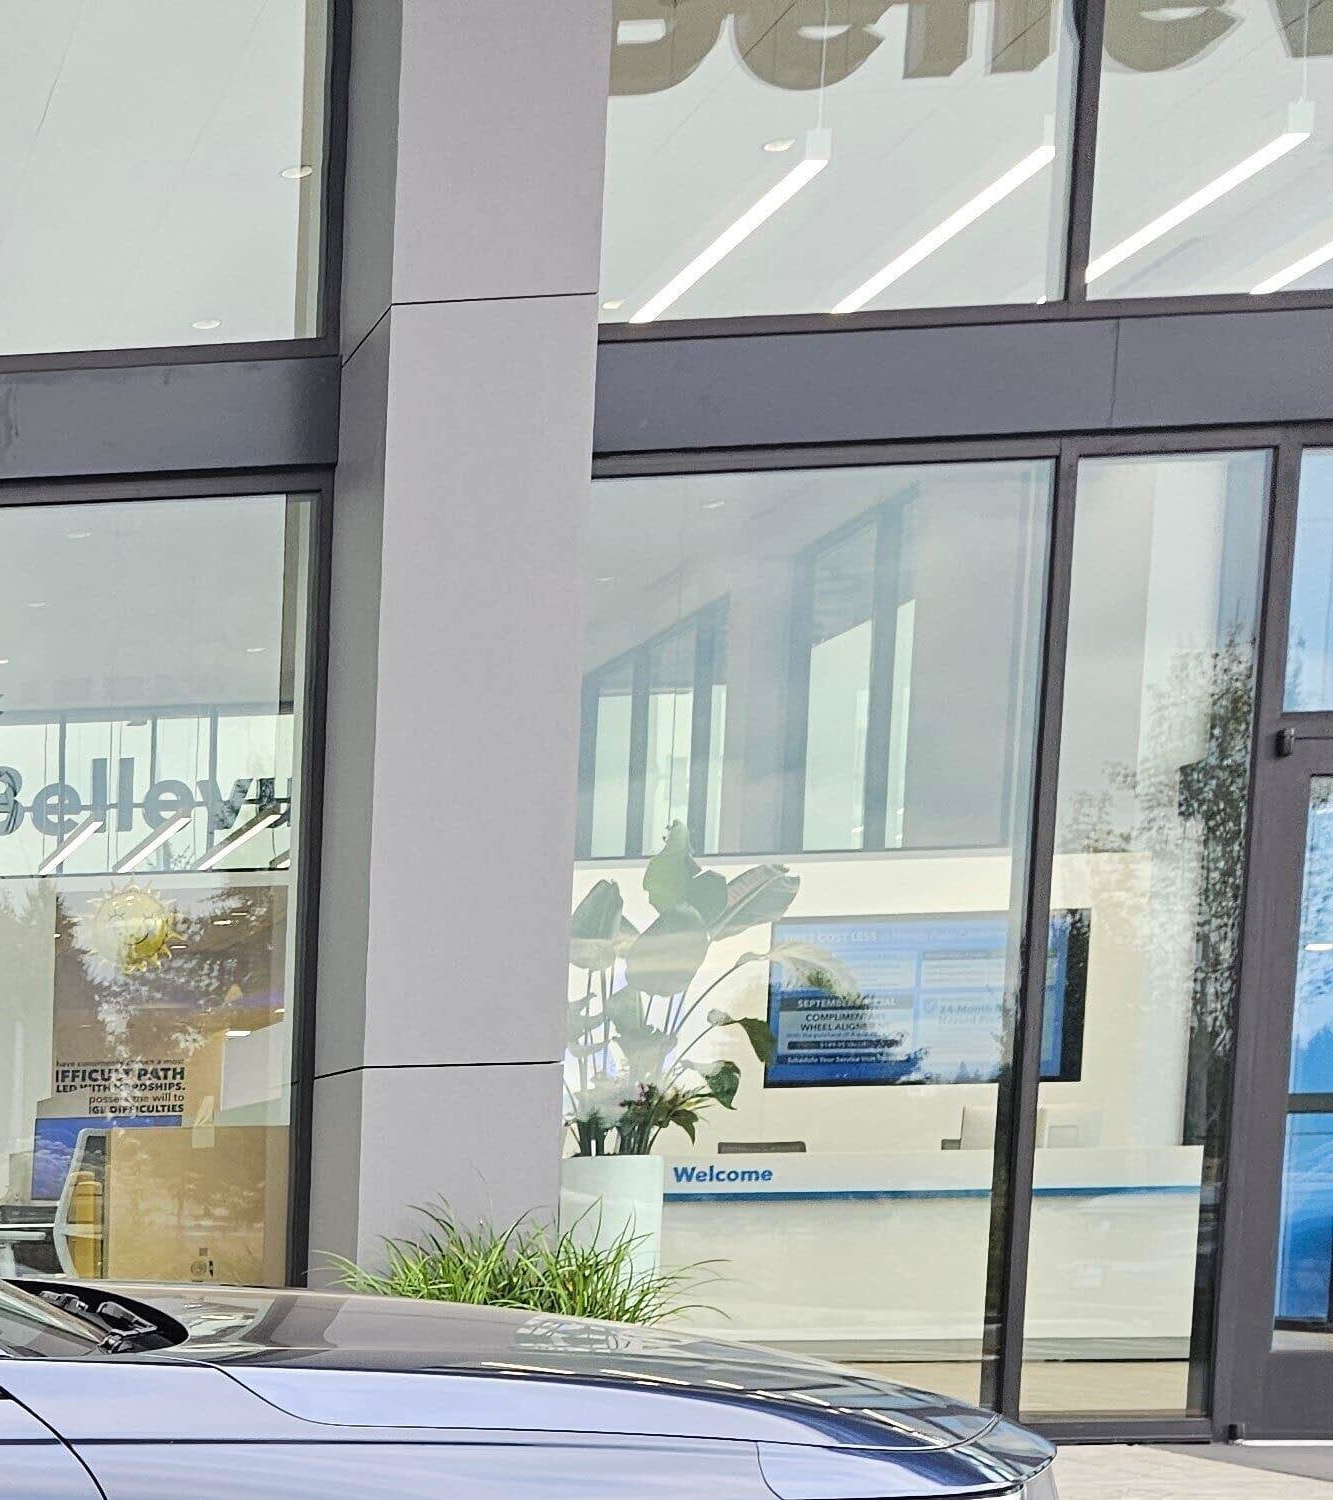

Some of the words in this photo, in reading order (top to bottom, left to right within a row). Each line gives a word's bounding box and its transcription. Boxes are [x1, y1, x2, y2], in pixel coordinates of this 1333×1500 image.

[137, 1067, 185, 1081] PATH
[152, 1093, 171, 1102] will
[173, 1093, 185, 1102] to
[673, 1164, 773, 1183] Welcome
